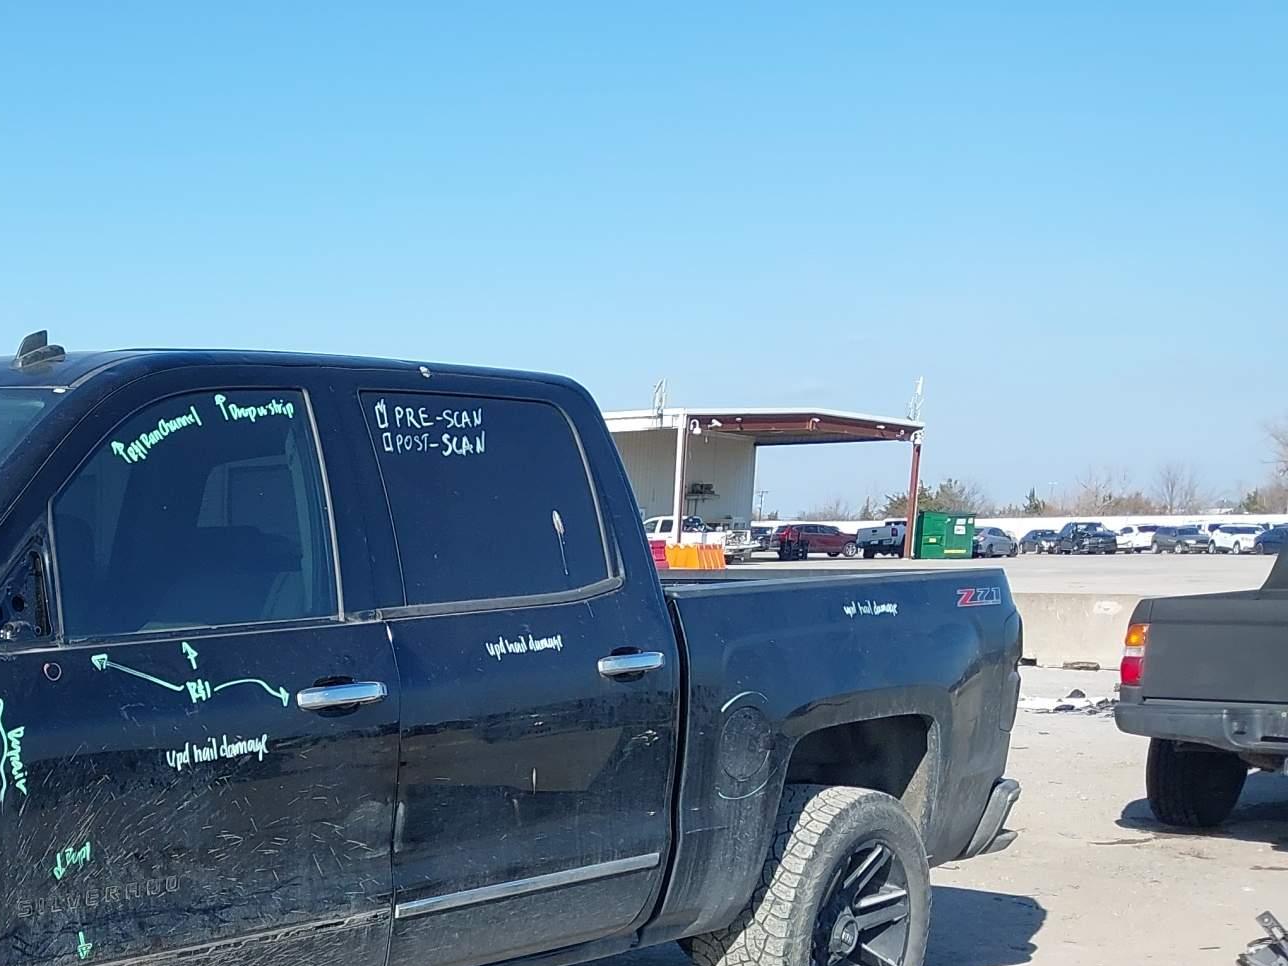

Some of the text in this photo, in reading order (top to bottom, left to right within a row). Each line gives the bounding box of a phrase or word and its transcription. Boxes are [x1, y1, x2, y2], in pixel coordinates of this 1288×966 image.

[394, 406, 482, 429] PRE-SCAN
[395, 430, 485, 457] POST-SCAN
[956, 587, 1002, 607] Z71
[17, 875, 180, 918] SILVERADO
